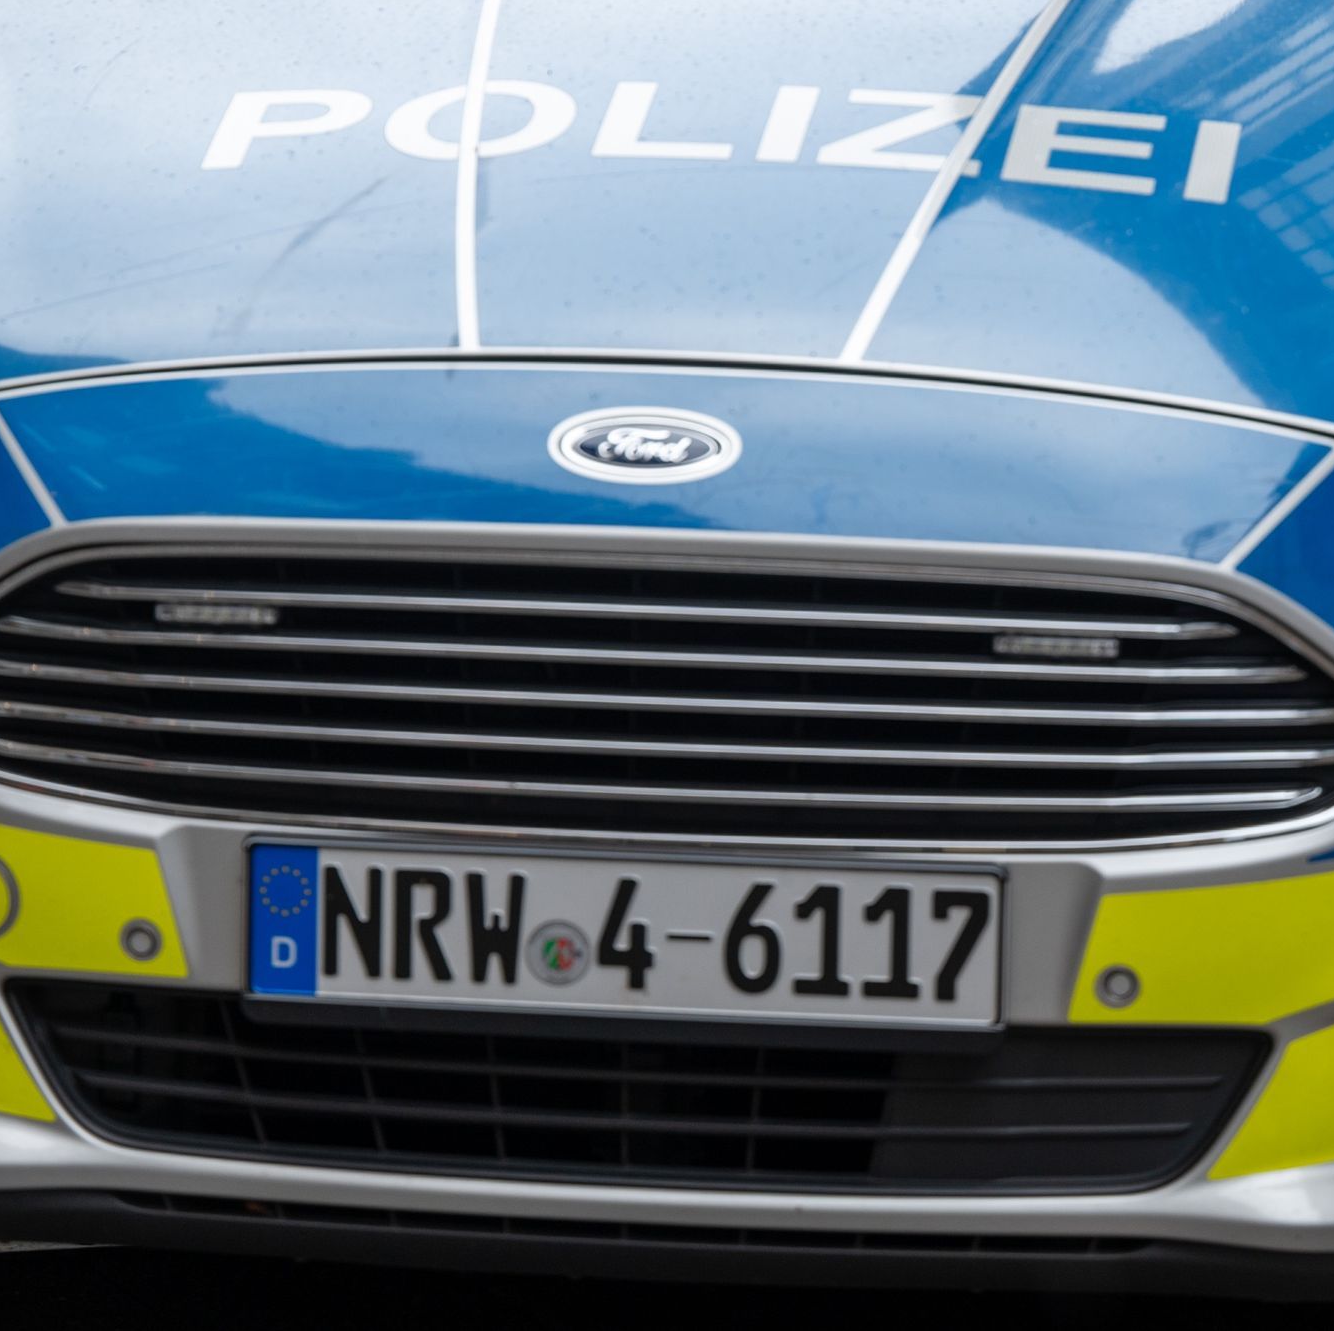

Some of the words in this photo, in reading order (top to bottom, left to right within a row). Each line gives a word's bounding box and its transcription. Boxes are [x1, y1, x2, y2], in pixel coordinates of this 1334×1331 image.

[201, 80, 1242, 205] POLIZEI
[598, 427, 693, 464] Ford
[270, 935, 298, 968] D
[323, 864, 526, 986] NRW
[597, 878, 991, 1002] 4-6117
